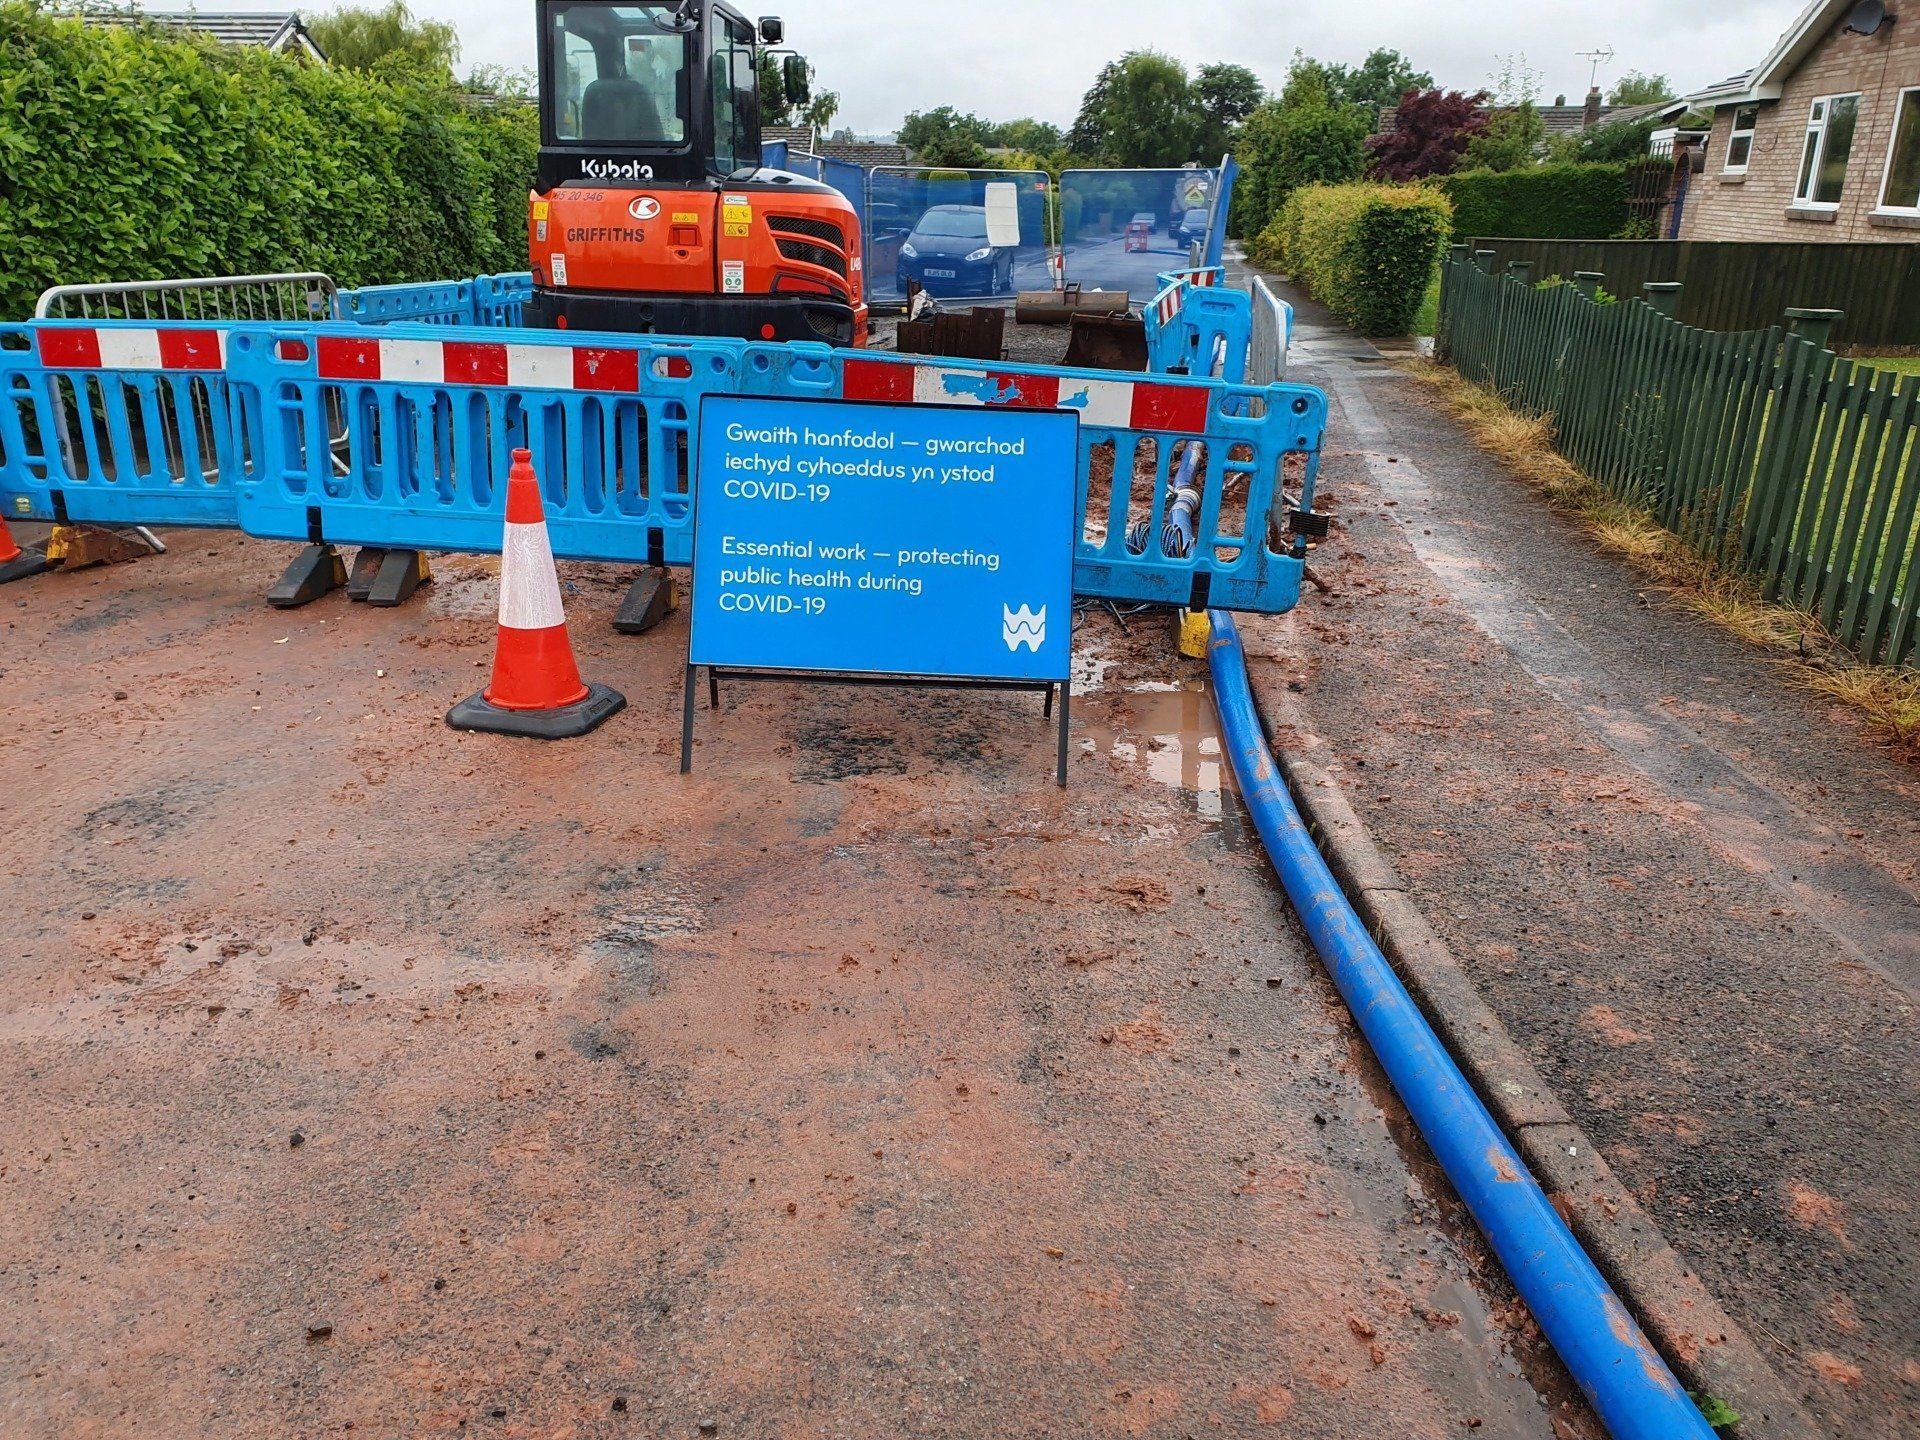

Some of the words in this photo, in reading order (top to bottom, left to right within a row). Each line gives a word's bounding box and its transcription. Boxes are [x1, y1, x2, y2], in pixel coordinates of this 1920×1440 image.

[581, 159, 654, 179] Kubota
[568, 191, 582, 200] 20
[583, 192, 605, 201] 346
[567, 227, 645, 242] GRIFFITHS
[726, 422, 798, 445] Gwaith
[804, 427, 894, 450] hanfodol
[925, 436, 1025, 456] gwarchod
[725, 452, 791, 476] iechyd
[796, 456, 906, 478] cyhoeddus
[911, 466, 935, 483] yn
[941, 465, 995, 484] ystod
[724, 479, 831, 503] COVID-19
[722, 536, 813, 558] Essential
[819, 543, 866, 560] work
[898, 548, 1000, 571] protecting
[720, 566, 782, 587] public
[789, 567, 851, 588] health
[857, 571, 922, 596] during
[719, 592, 826, 615] COVID-19
